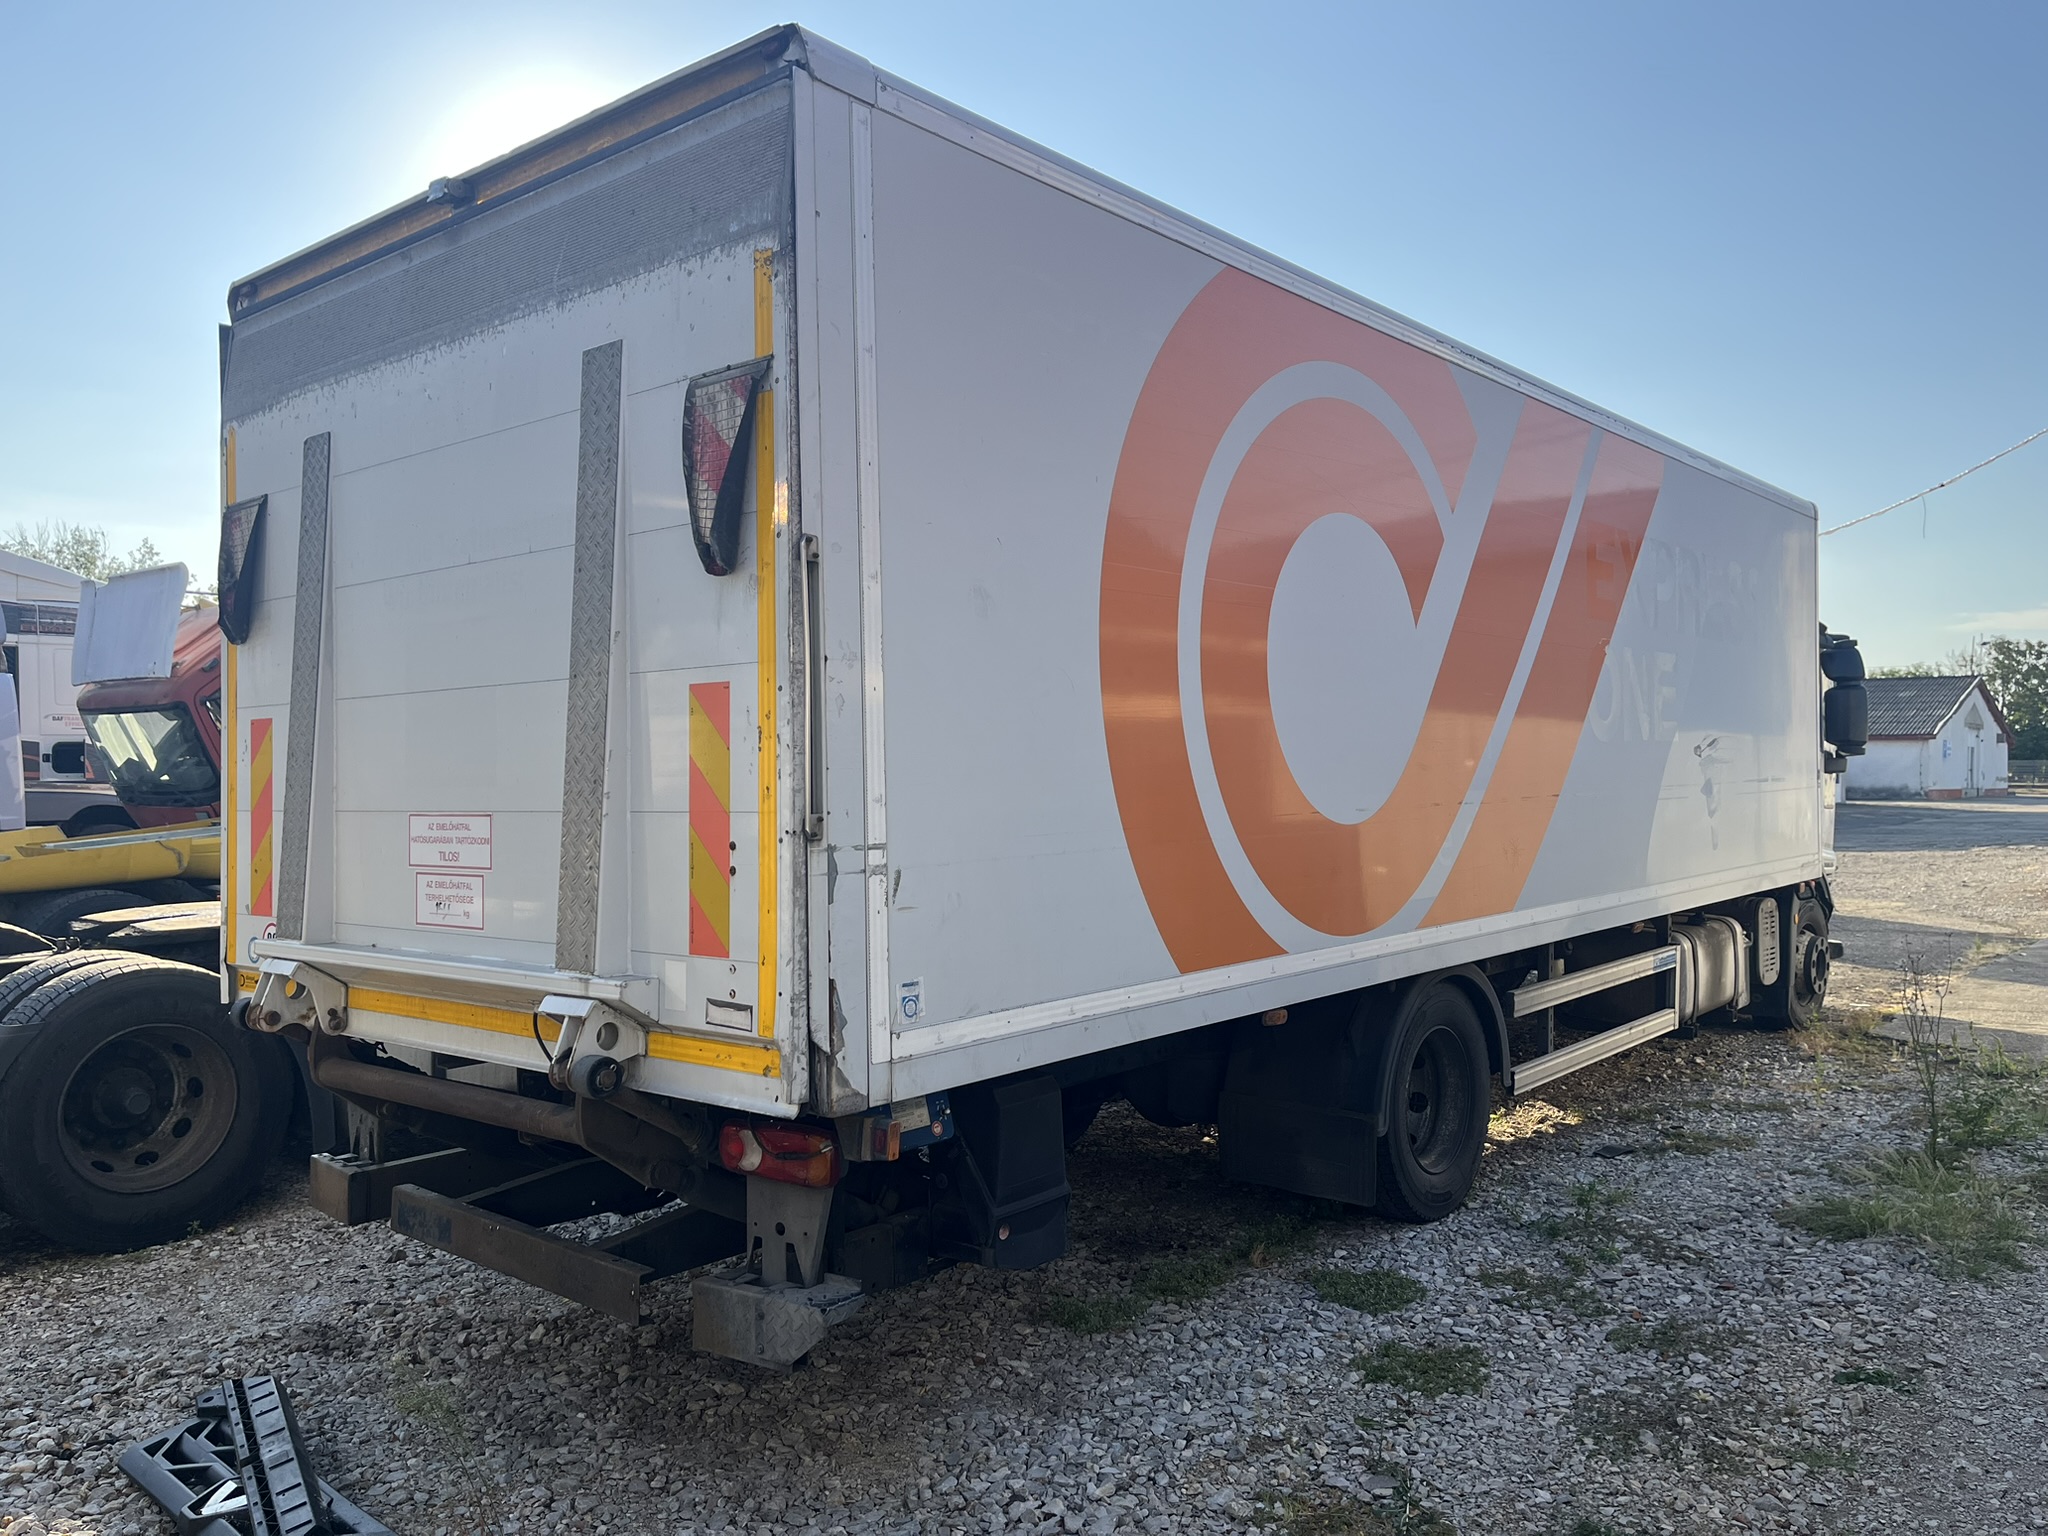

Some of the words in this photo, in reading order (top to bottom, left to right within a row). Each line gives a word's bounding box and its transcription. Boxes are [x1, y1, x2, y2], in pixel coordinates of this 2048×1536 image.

[1589, 644, 1681, 743] ONE
[428, 823, 434, 831] AZ
[438, 850, 460, 863] TILOS!
[426, 880, 433, 888] AZ
[463, 909, 470, 920] kg
